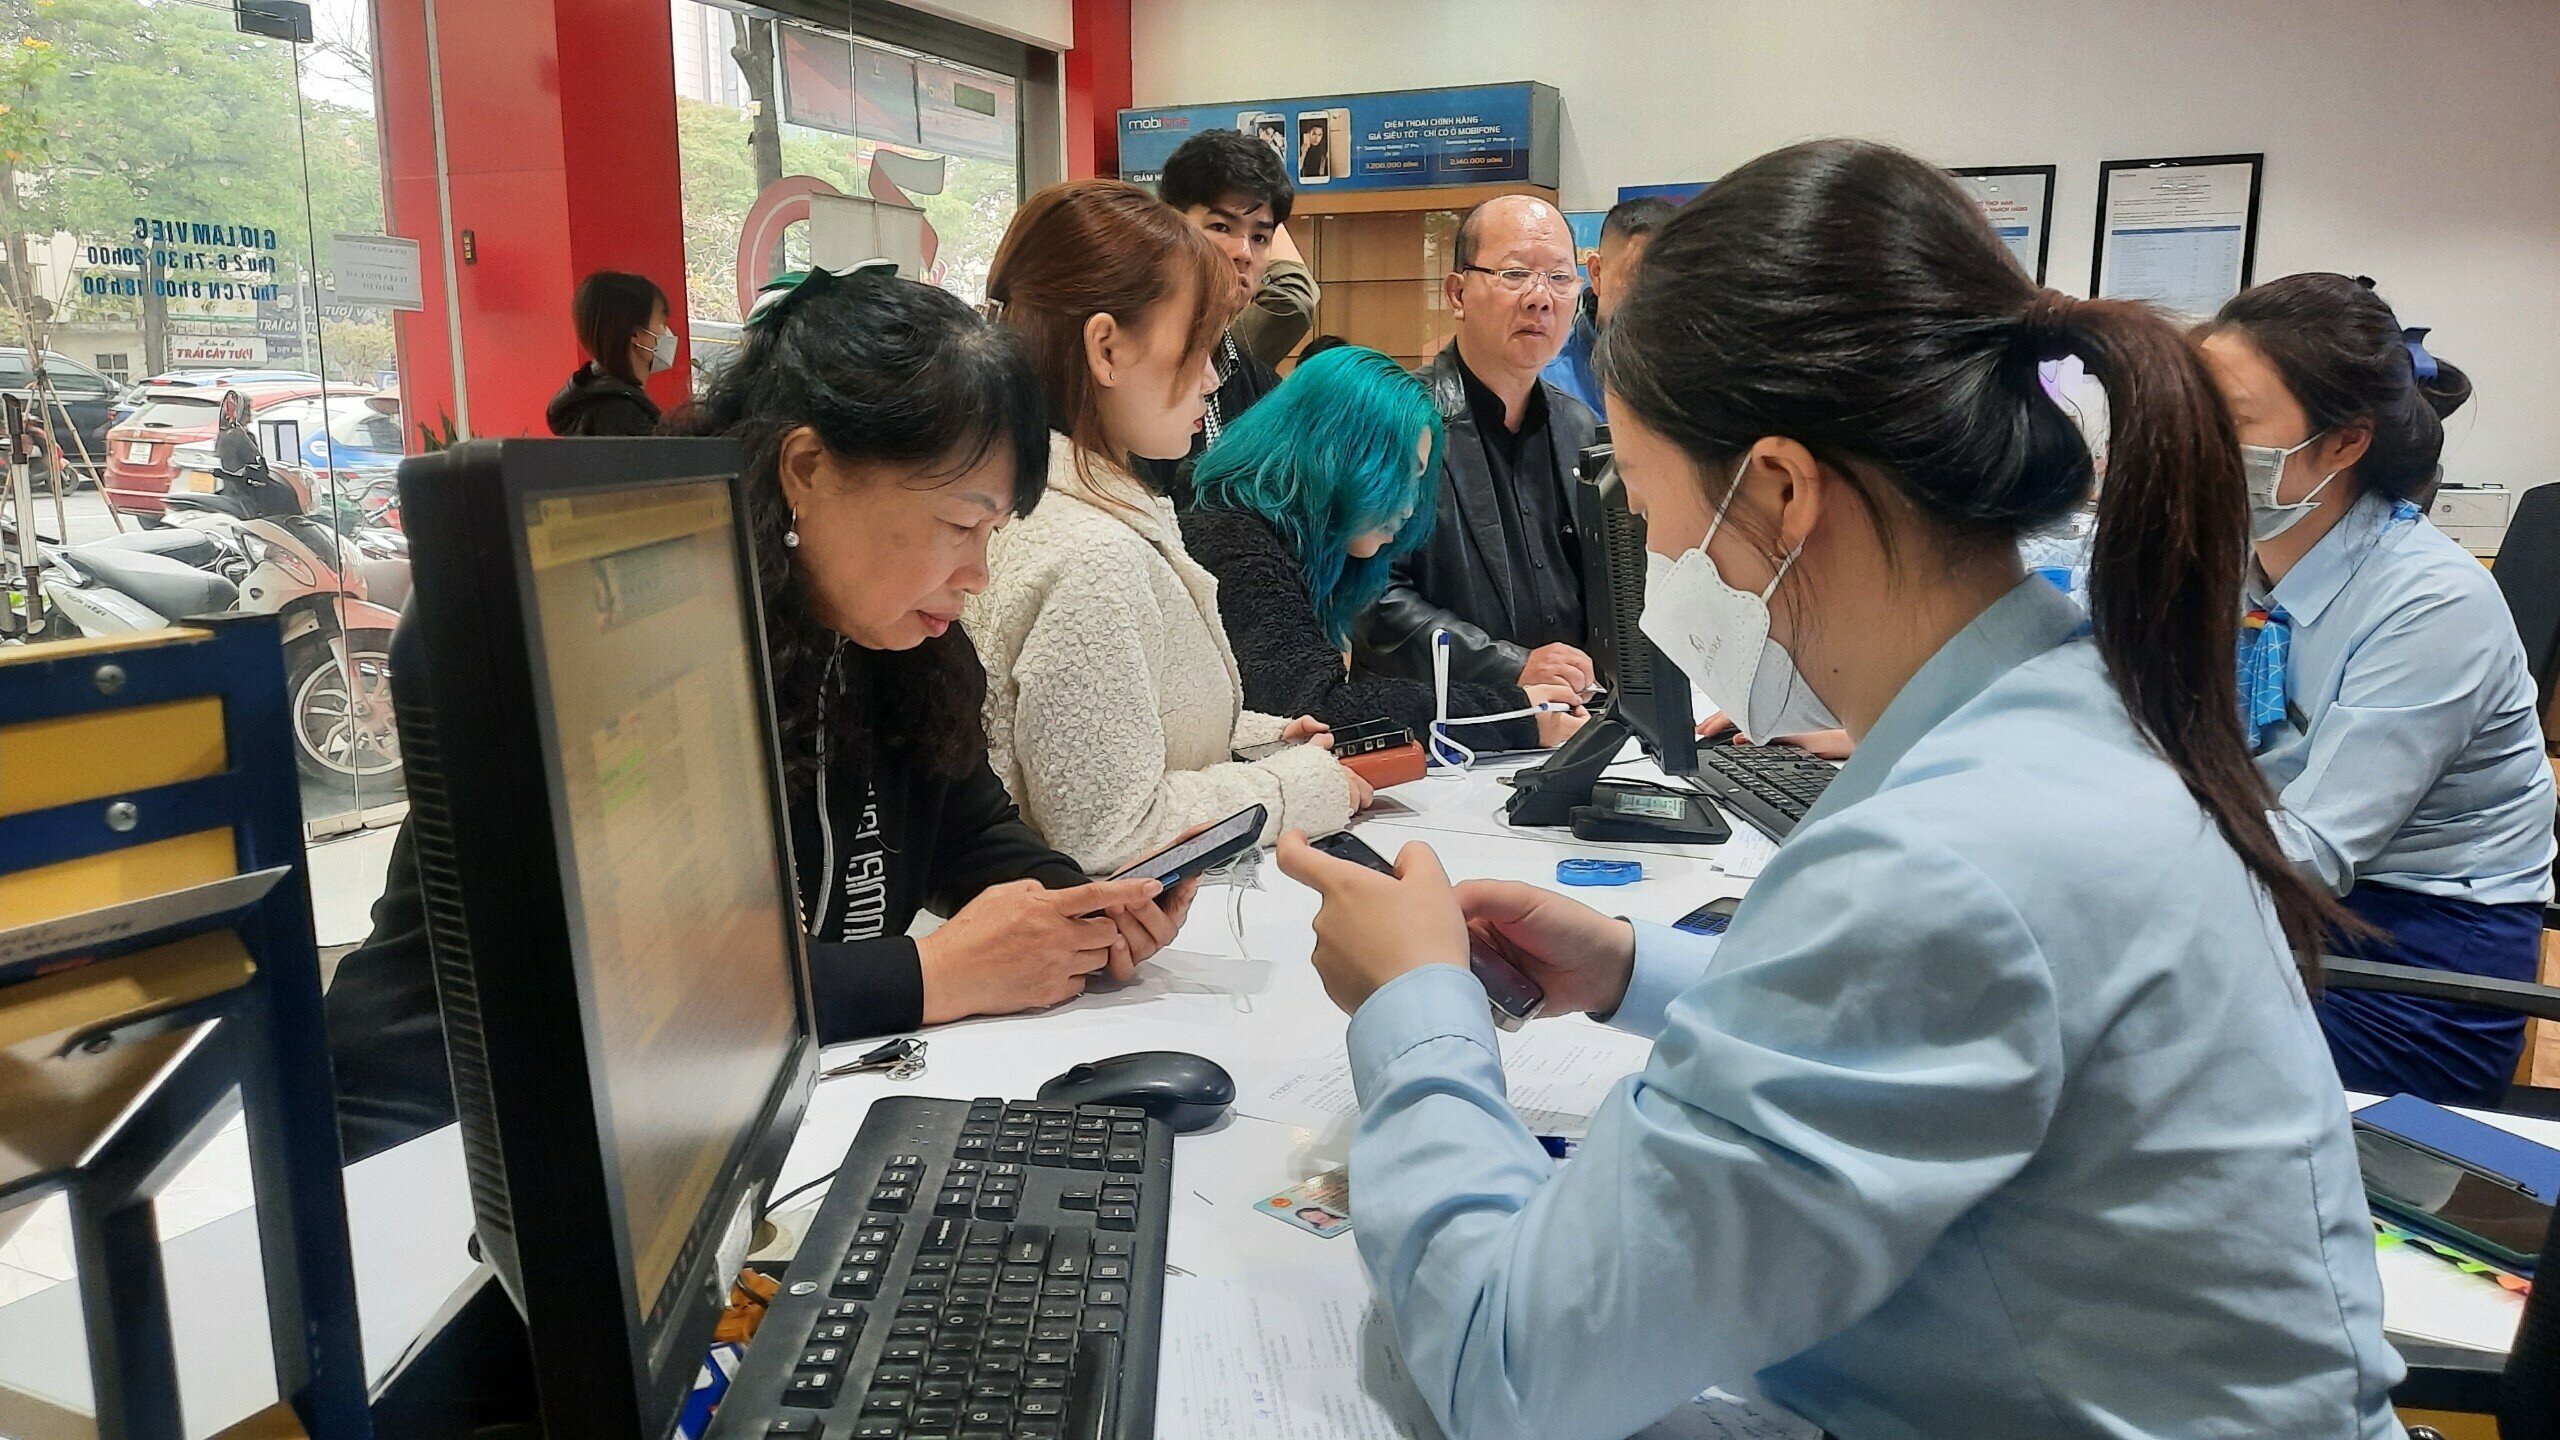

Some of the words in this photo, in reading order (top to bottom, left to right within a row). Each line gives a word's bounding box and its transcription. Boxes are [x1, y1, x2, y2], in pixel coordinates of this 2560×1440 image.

[1458, 125, 1501, 135] MOBIFONE
[928, 1390, 942, 1398] Y
[950, 1316, 964, 1324] O
[973, 1412, 989, 1422] G
[981, 1386, 994, 1394] H
[1026, 1404, 1042, 1412] B
